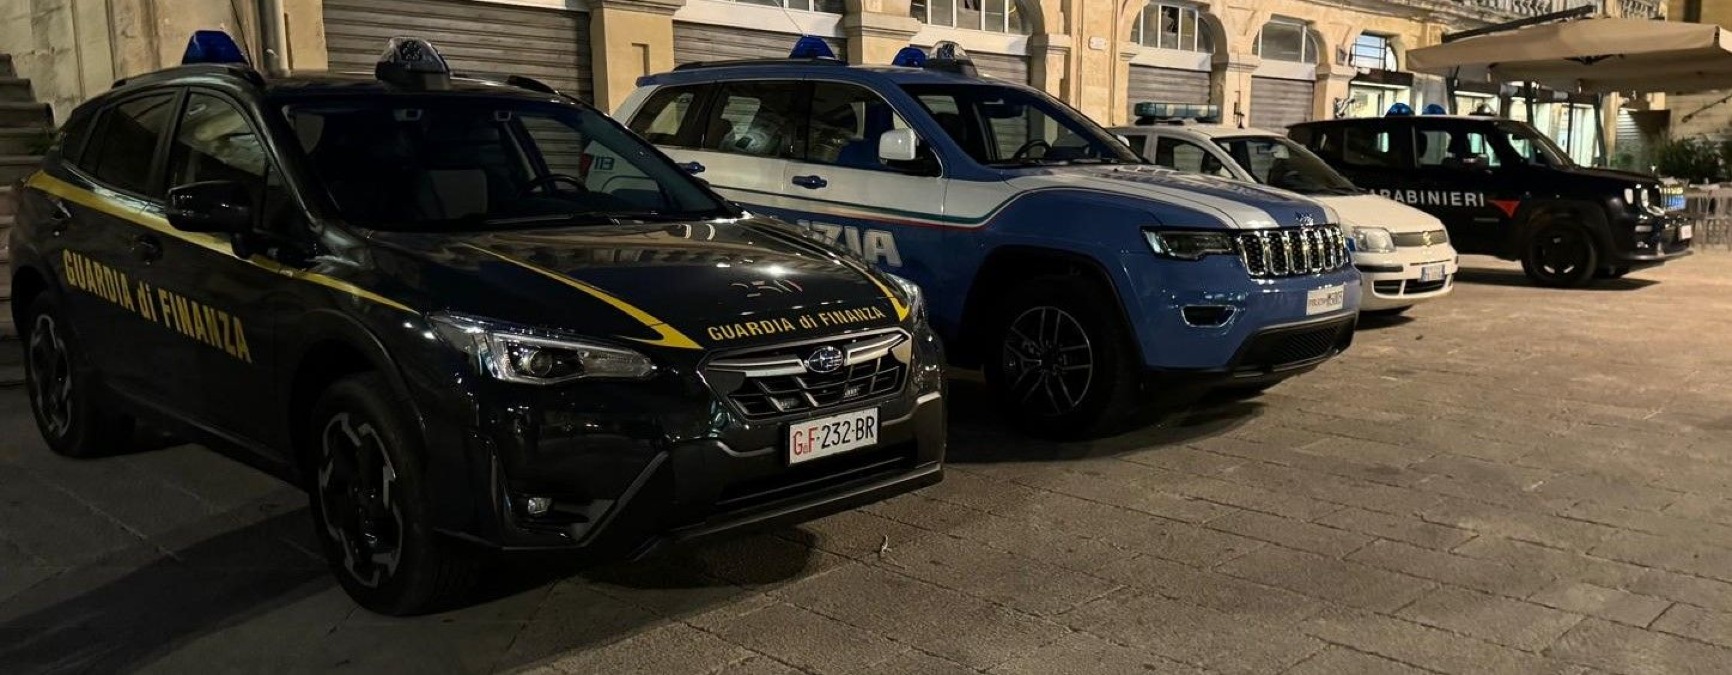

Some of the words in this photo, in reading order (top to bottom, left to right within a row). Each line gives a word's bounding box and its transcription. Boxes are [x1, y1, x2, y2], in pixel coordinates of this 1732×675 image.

[797, 219, 903, 268] ZIA
[62, 249, 135, 312] GUARDIA
[137, 280, 157, 322] di
[158, 287, 252, 364] FINANZA
[707, 317, 796, 341] GUARDIA
[800, 314, 818, 330] di
[818, 305, 887, 327] FINANZA
